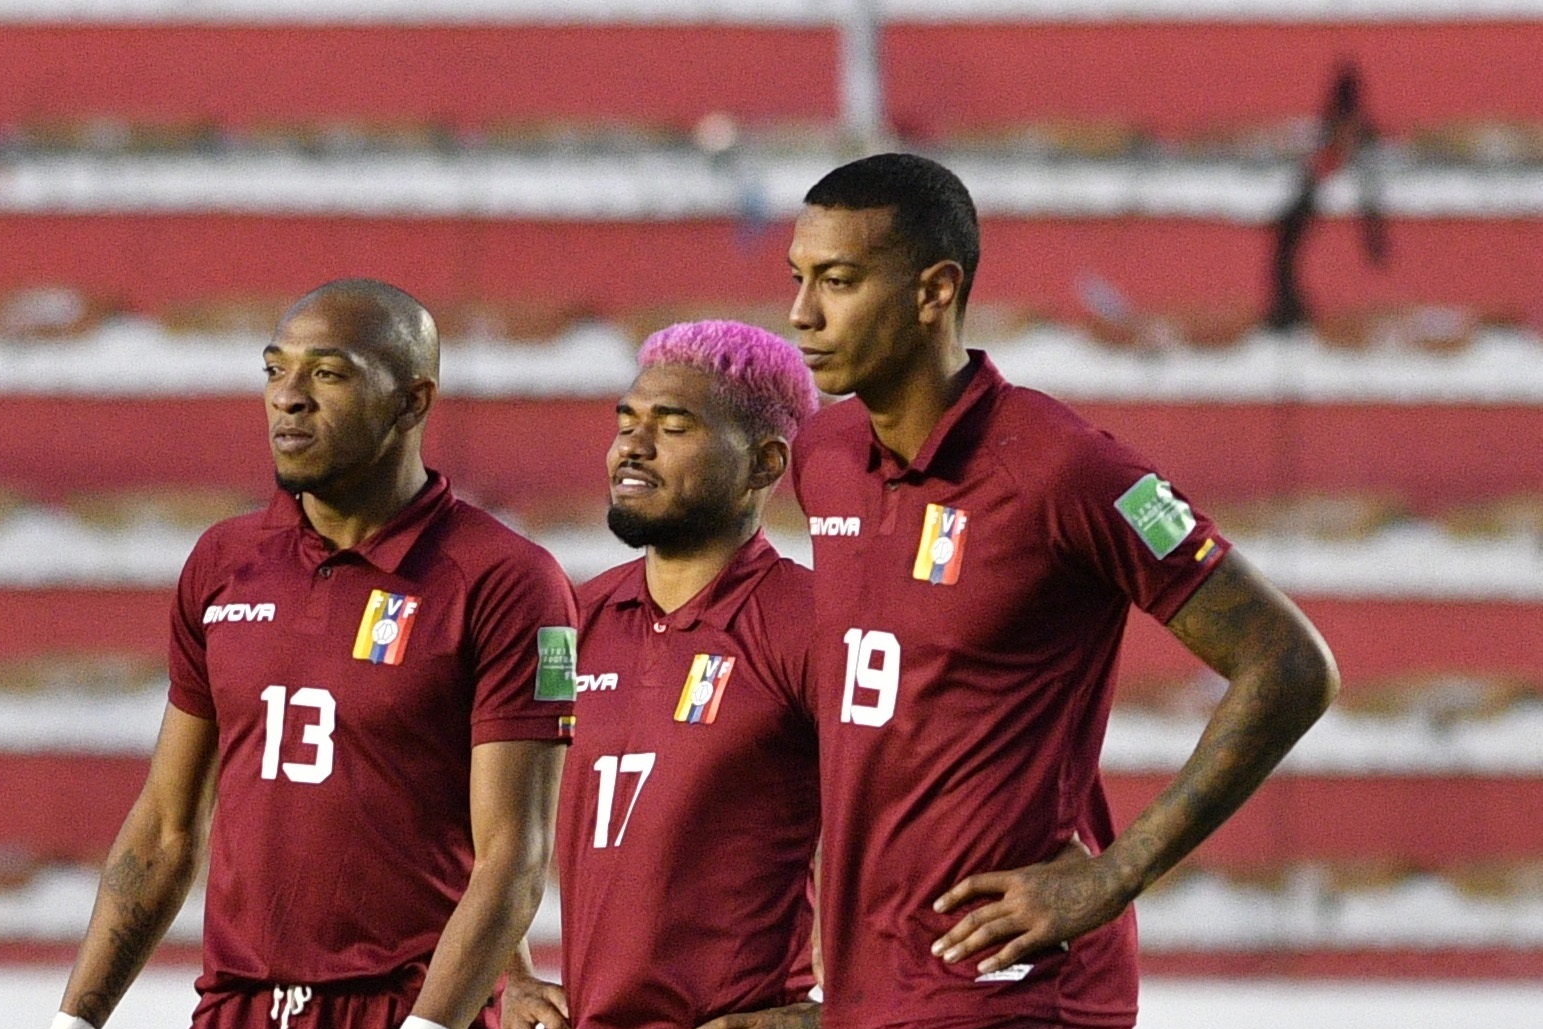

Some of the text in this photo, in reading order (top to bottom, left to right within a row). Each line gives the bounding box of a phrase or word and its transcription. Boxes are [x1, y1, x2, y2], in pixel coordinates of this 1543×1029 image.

[203, 603, 276, 624] GIVOVA
[840, 627, 901, 728] 19
[260, 684, 337, 784] 13
[593, 752, 656, 848] 17
